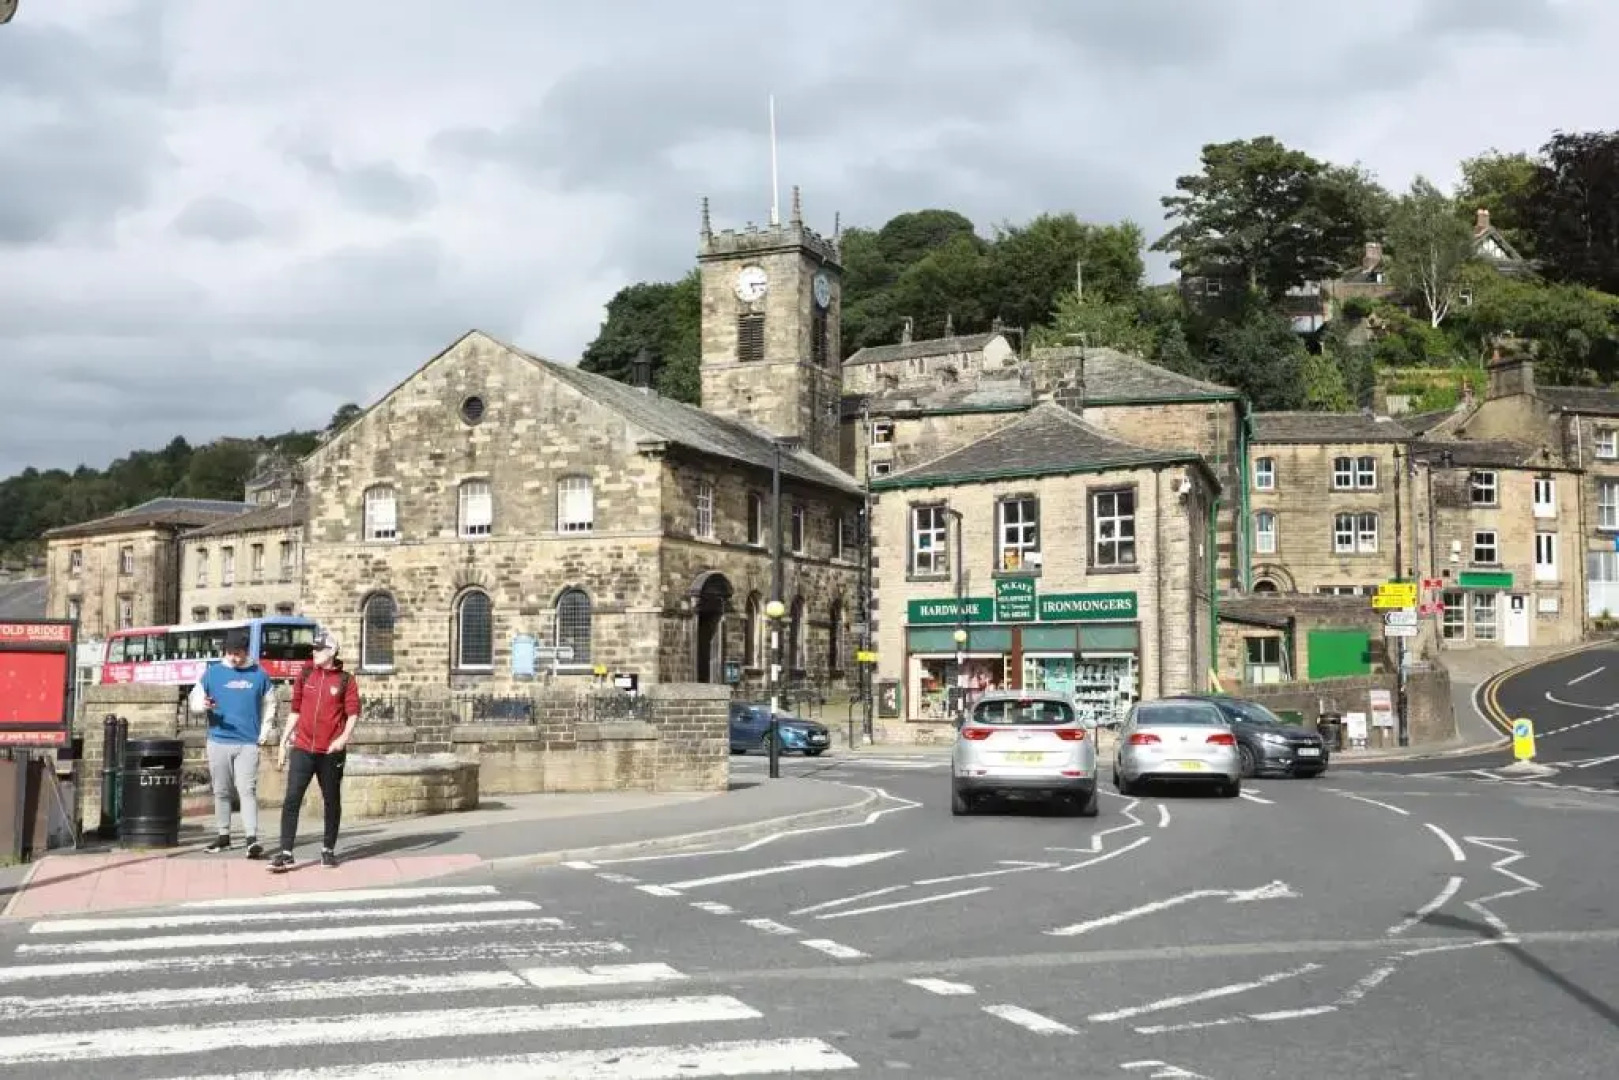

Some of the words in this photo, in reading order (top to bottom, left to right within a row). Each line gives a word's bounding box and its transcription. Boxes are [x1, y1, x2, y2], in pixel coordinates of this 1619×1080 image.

[920, 603, 980, 616] HARDWARE
[1042, 598, 1132, 613] IRONMONGERS
[2, 625, 24, 635] OLD
[27, 625, 64, 636] BRIDGE
